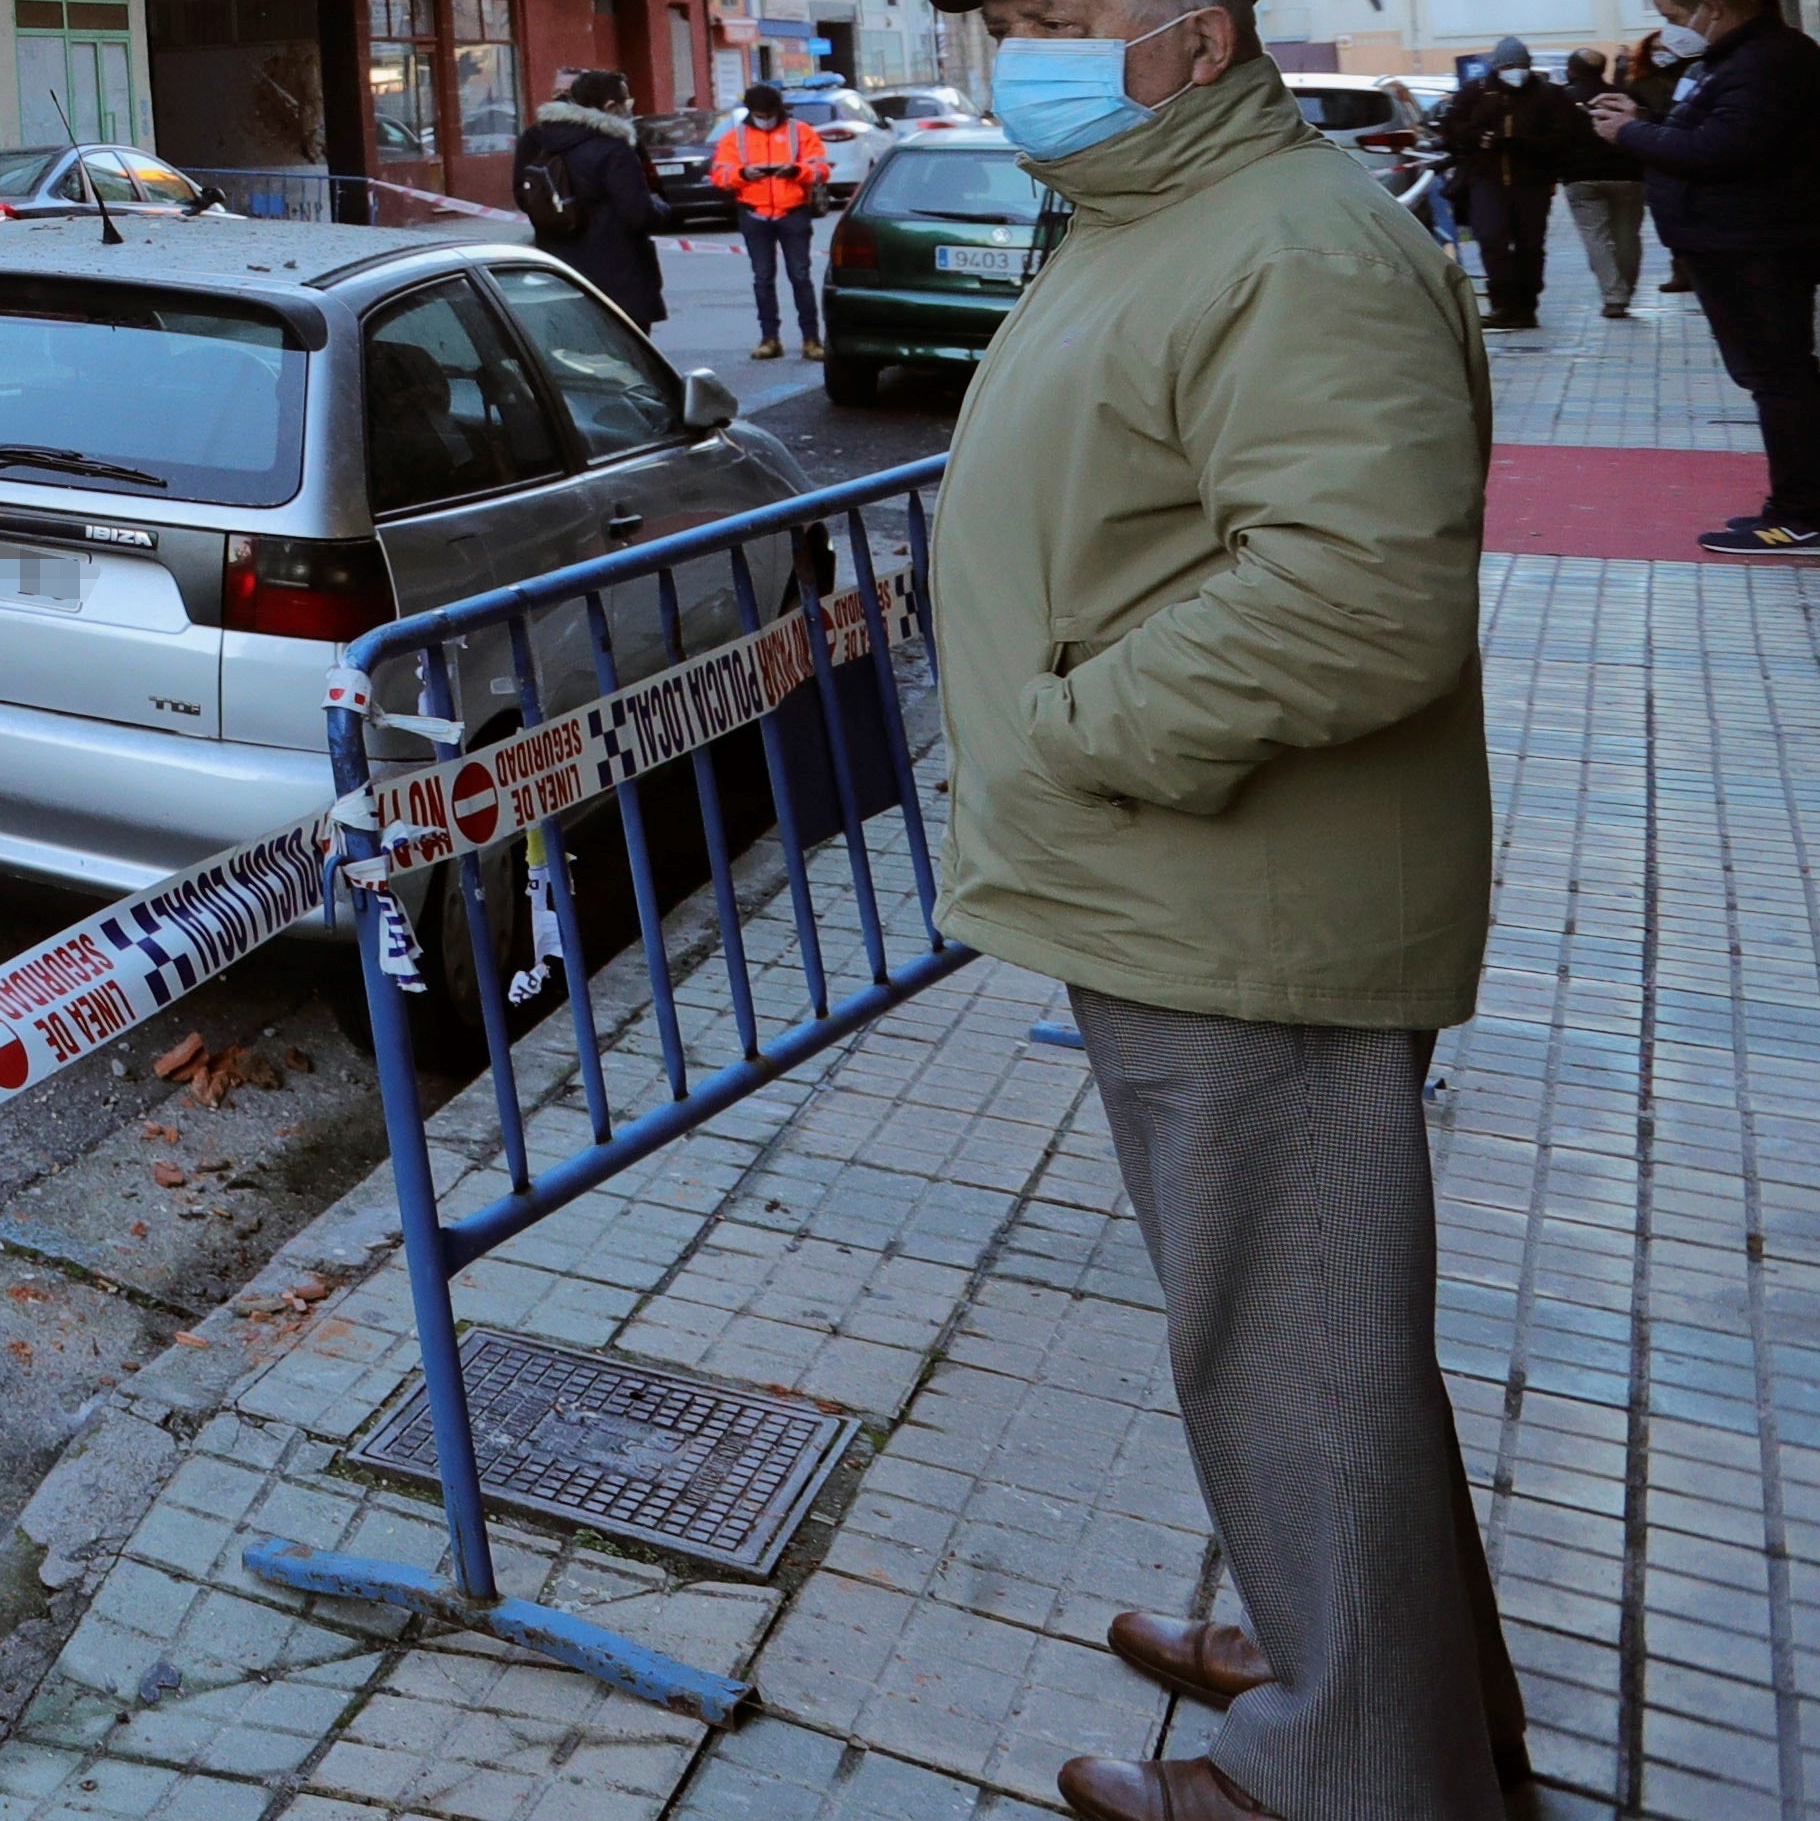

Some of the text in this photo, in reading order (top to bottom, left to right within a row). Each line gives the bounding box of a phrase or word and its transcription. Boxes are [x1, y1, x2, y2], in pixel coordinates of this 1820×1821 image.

[954, 250, 1010, 270] 9403
[83, 524, 153, 548] IBIZA
[627, 678, 695, 768] LOCAL
[686, 645, 764, 740] POLICIA
[495, 718, 583, 788] SEGURIDAD
[511, 763, 583, 827] LINEA DE
[150, 865, 260, 976] LOCAL
[33, 979, 137, 1063] LINEA DE
